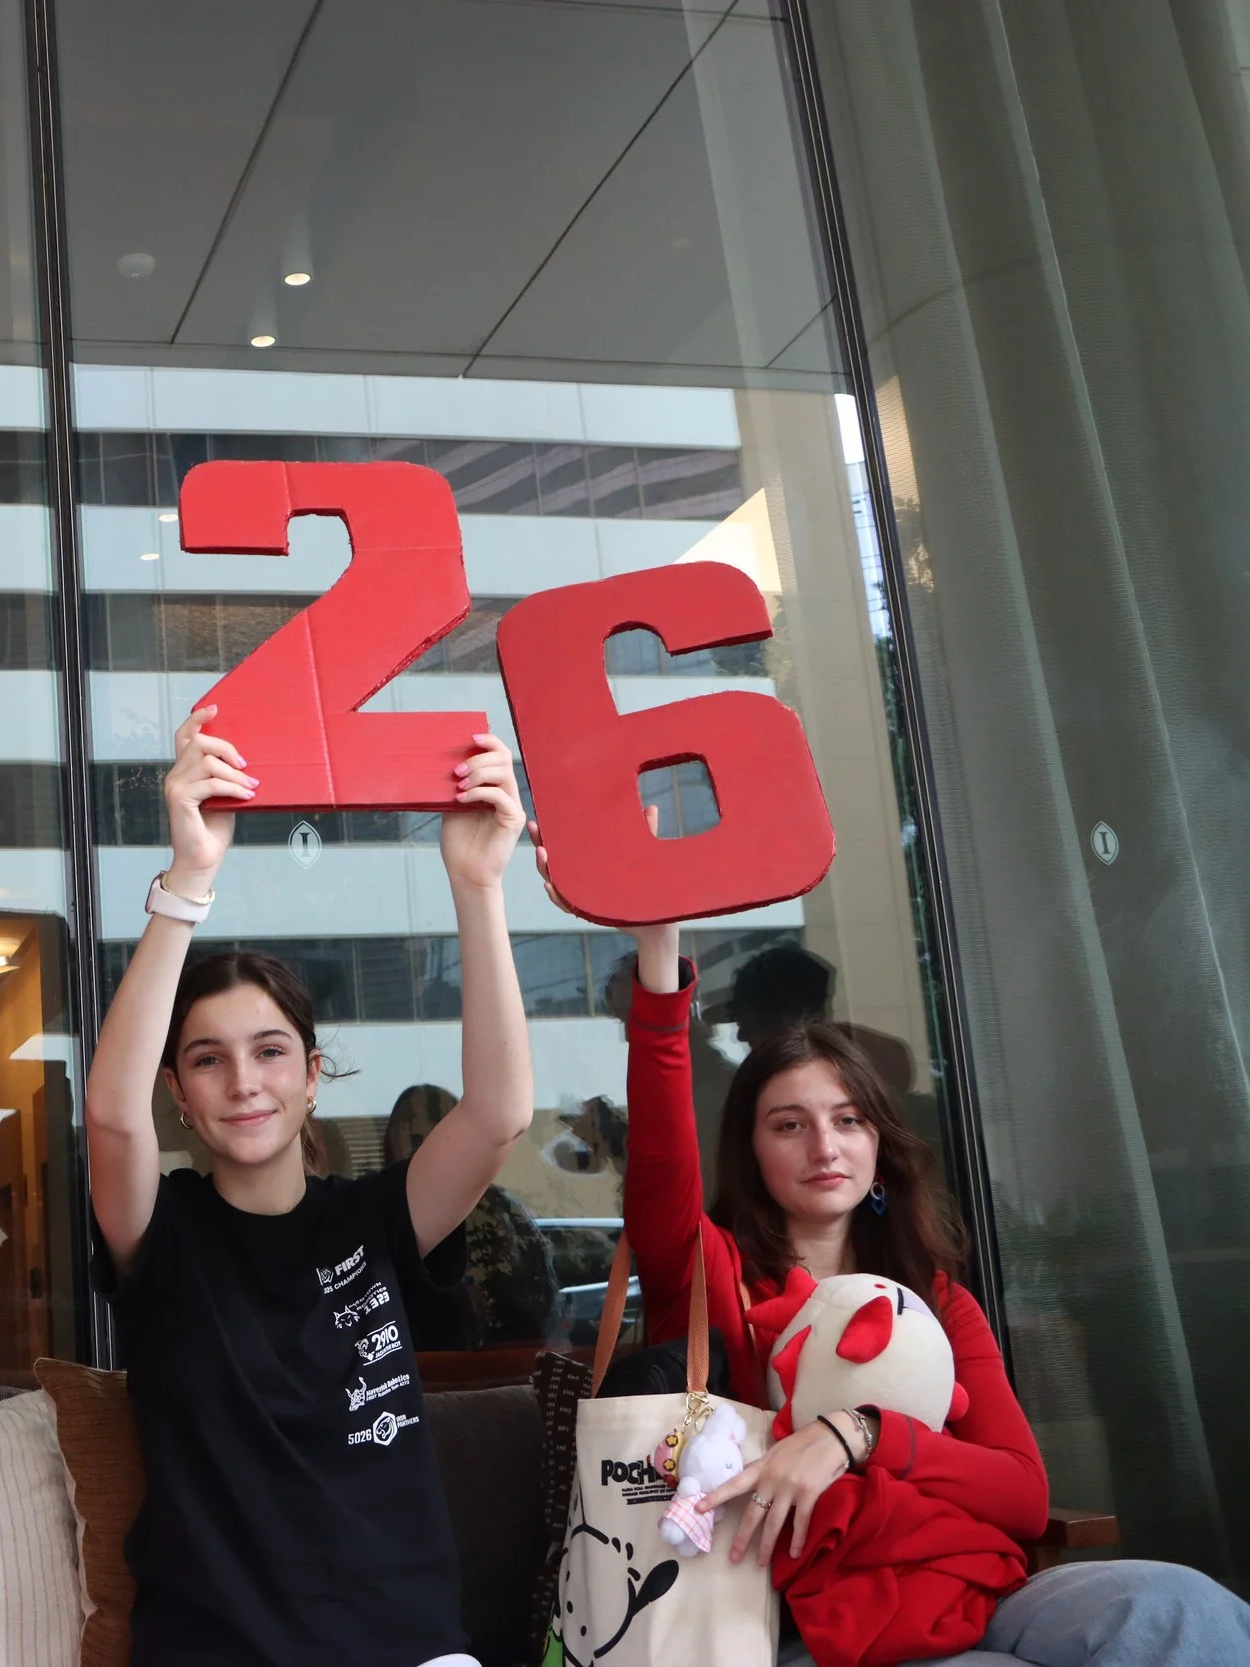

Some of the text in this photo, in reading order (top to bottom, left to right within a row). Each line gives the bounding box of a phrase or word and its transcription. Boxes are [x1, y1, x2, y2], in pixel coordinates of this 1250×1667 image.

[334, 1245, 365, 1276] FIRST
[333, 1261, 367, 1289] CHAMPIONS
[363, 1291, 390, 1315] 1323
[371, 1325, 399, 1351] 2910
[348, 1428, 372, 1445] 5026
